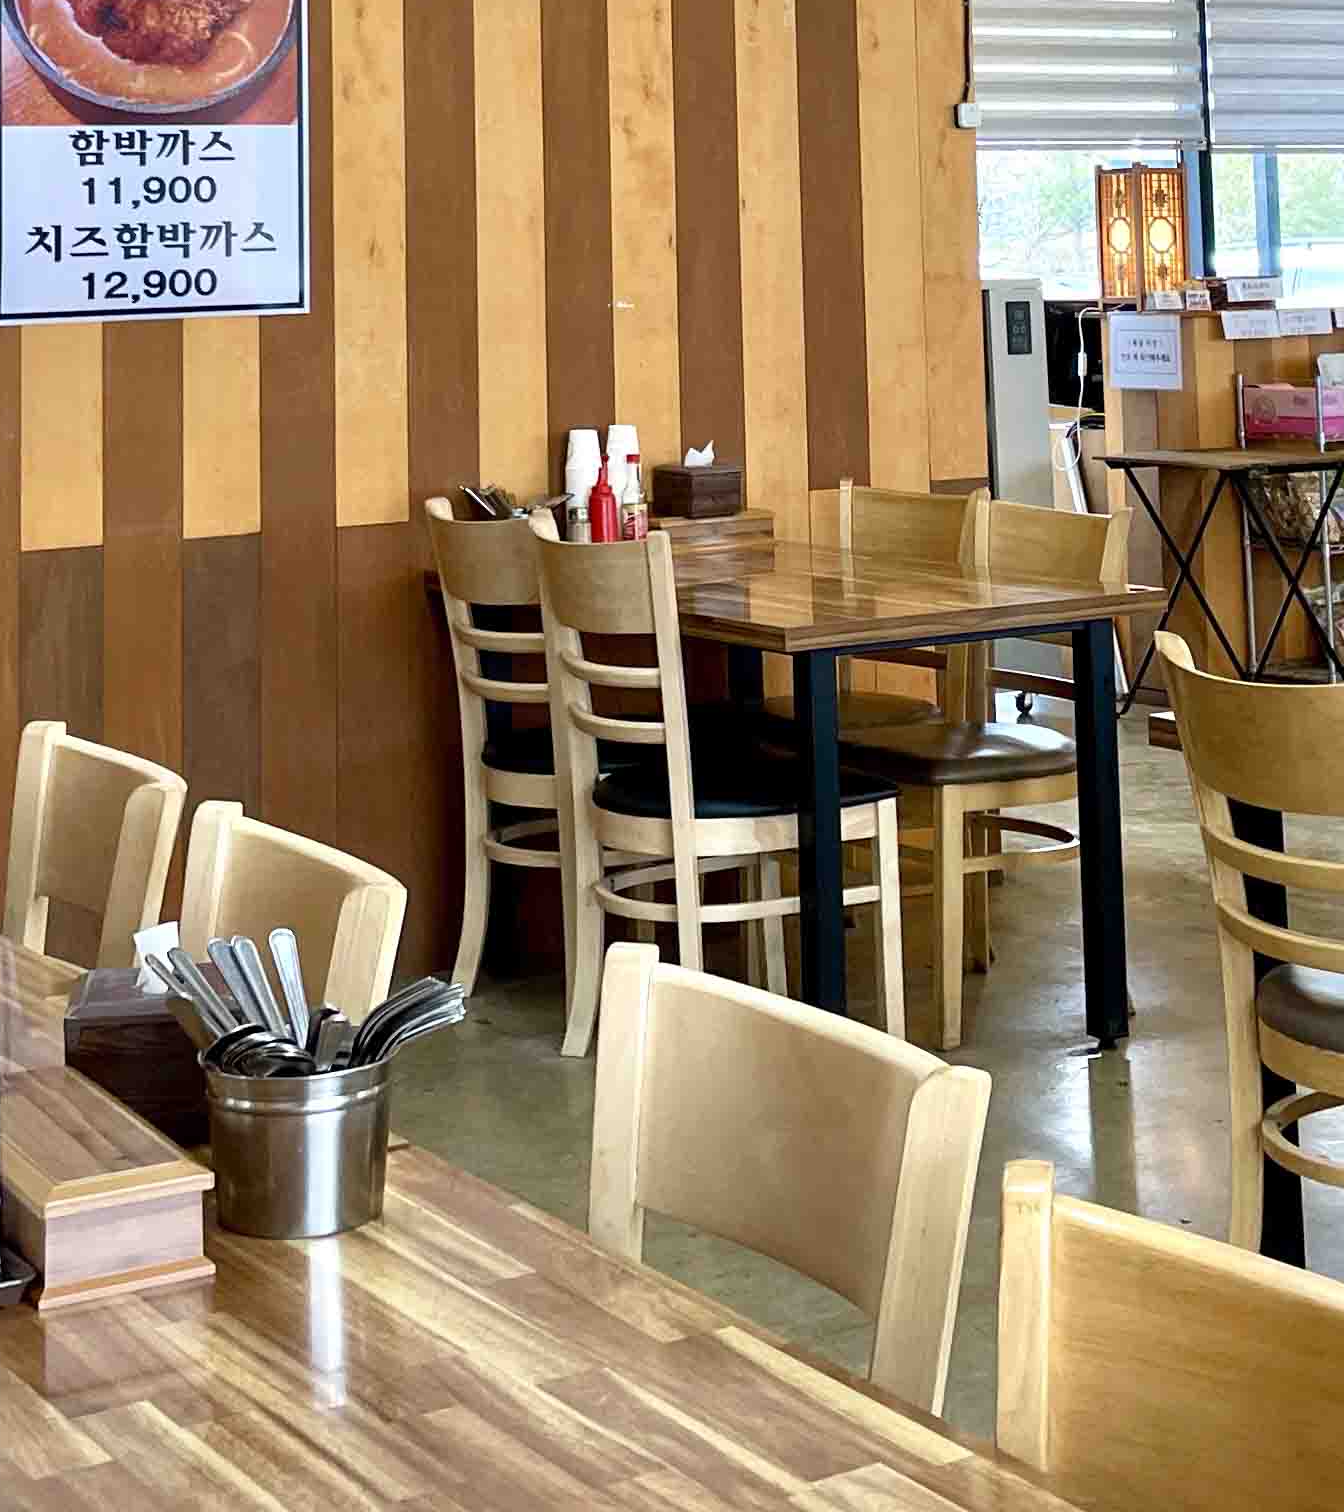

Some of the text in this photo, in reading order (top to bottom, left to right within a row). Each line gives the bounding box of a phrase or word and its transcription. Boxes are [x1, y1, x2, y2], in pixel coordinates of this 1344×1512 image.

[69, 130, 235, 166] 함박까스
[83, 176, 216, 209] 11,900
[25, 221, 276, 262] 치즈함박까스
[83, 269, 217, 303] 12,900
